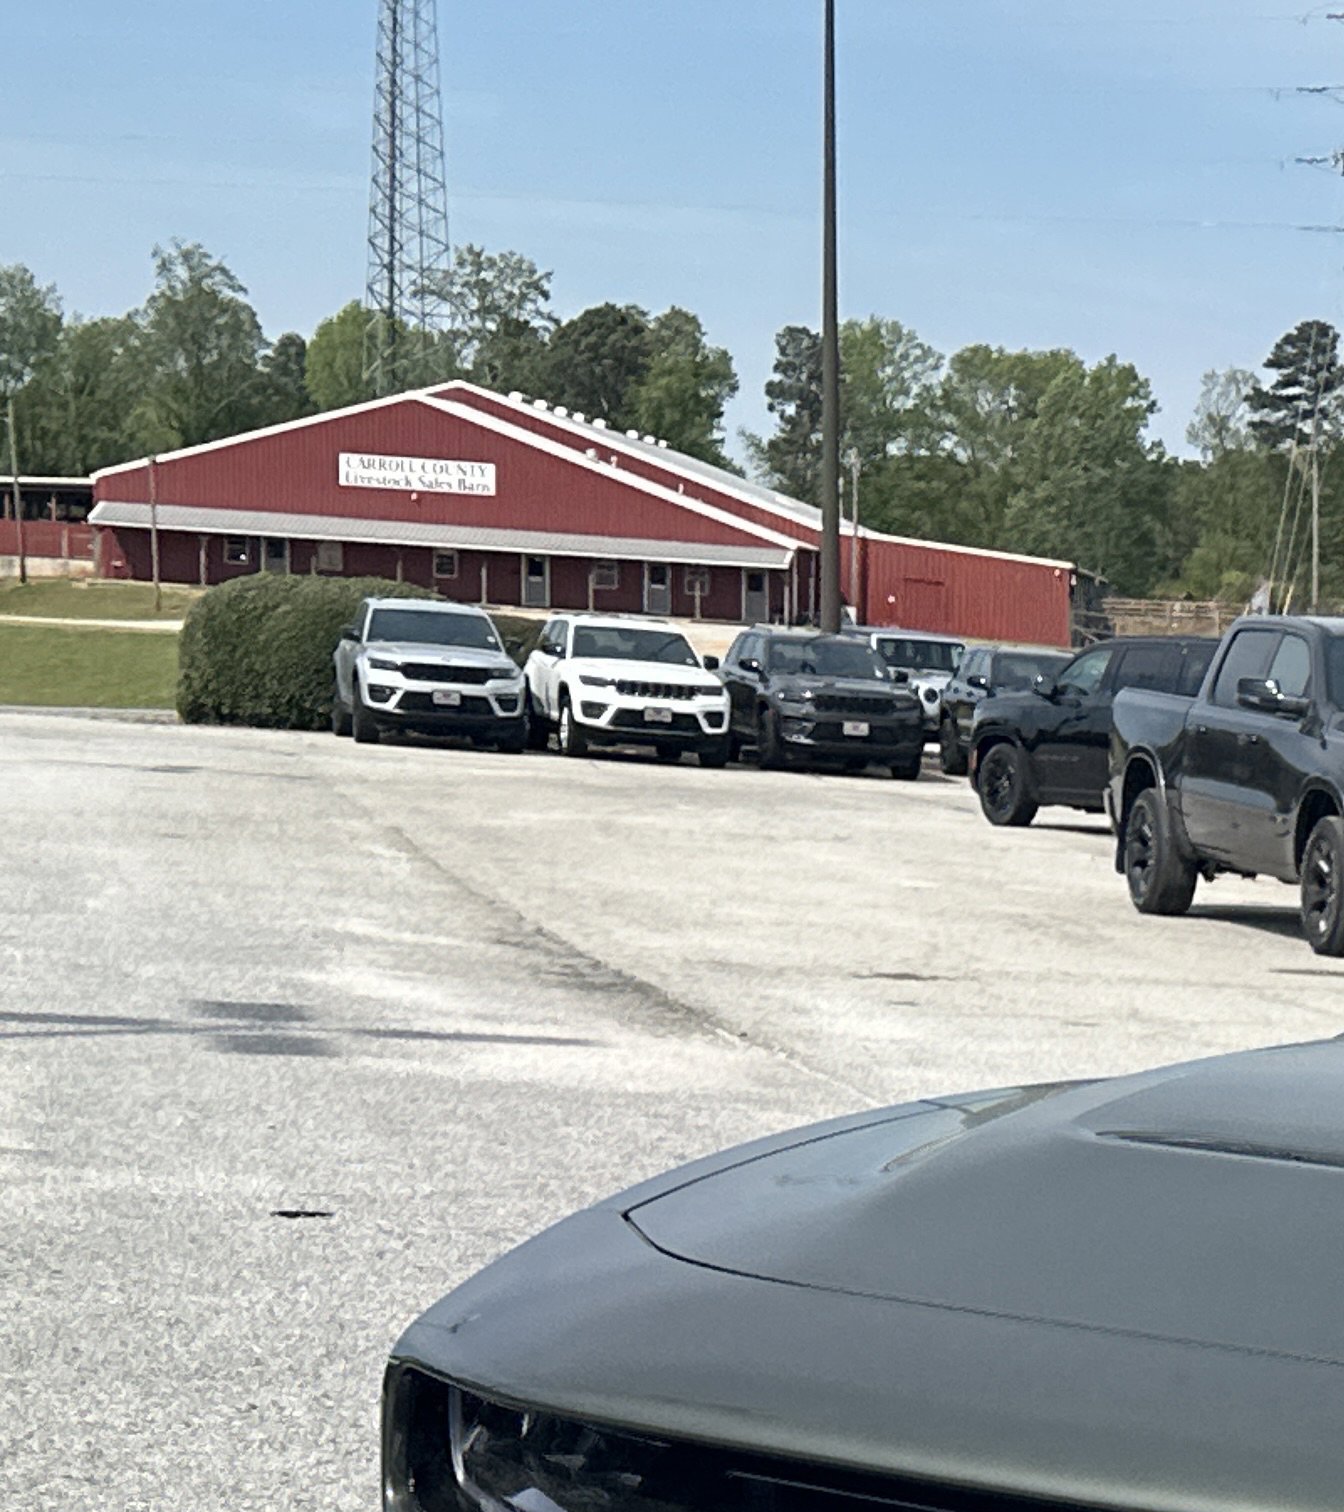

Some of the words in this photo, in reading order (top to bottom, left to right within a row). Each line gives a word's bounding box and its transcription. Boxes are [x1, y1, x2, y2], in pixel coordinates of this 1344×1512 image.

[346, 456, 416, 473] CARROLL
[420, 461, 488, 478] COUNTY
[345, 470, 412, 488] Livestock
[418, 475, 452, 489] Sales
[458, 478, 491, 492] Barn
